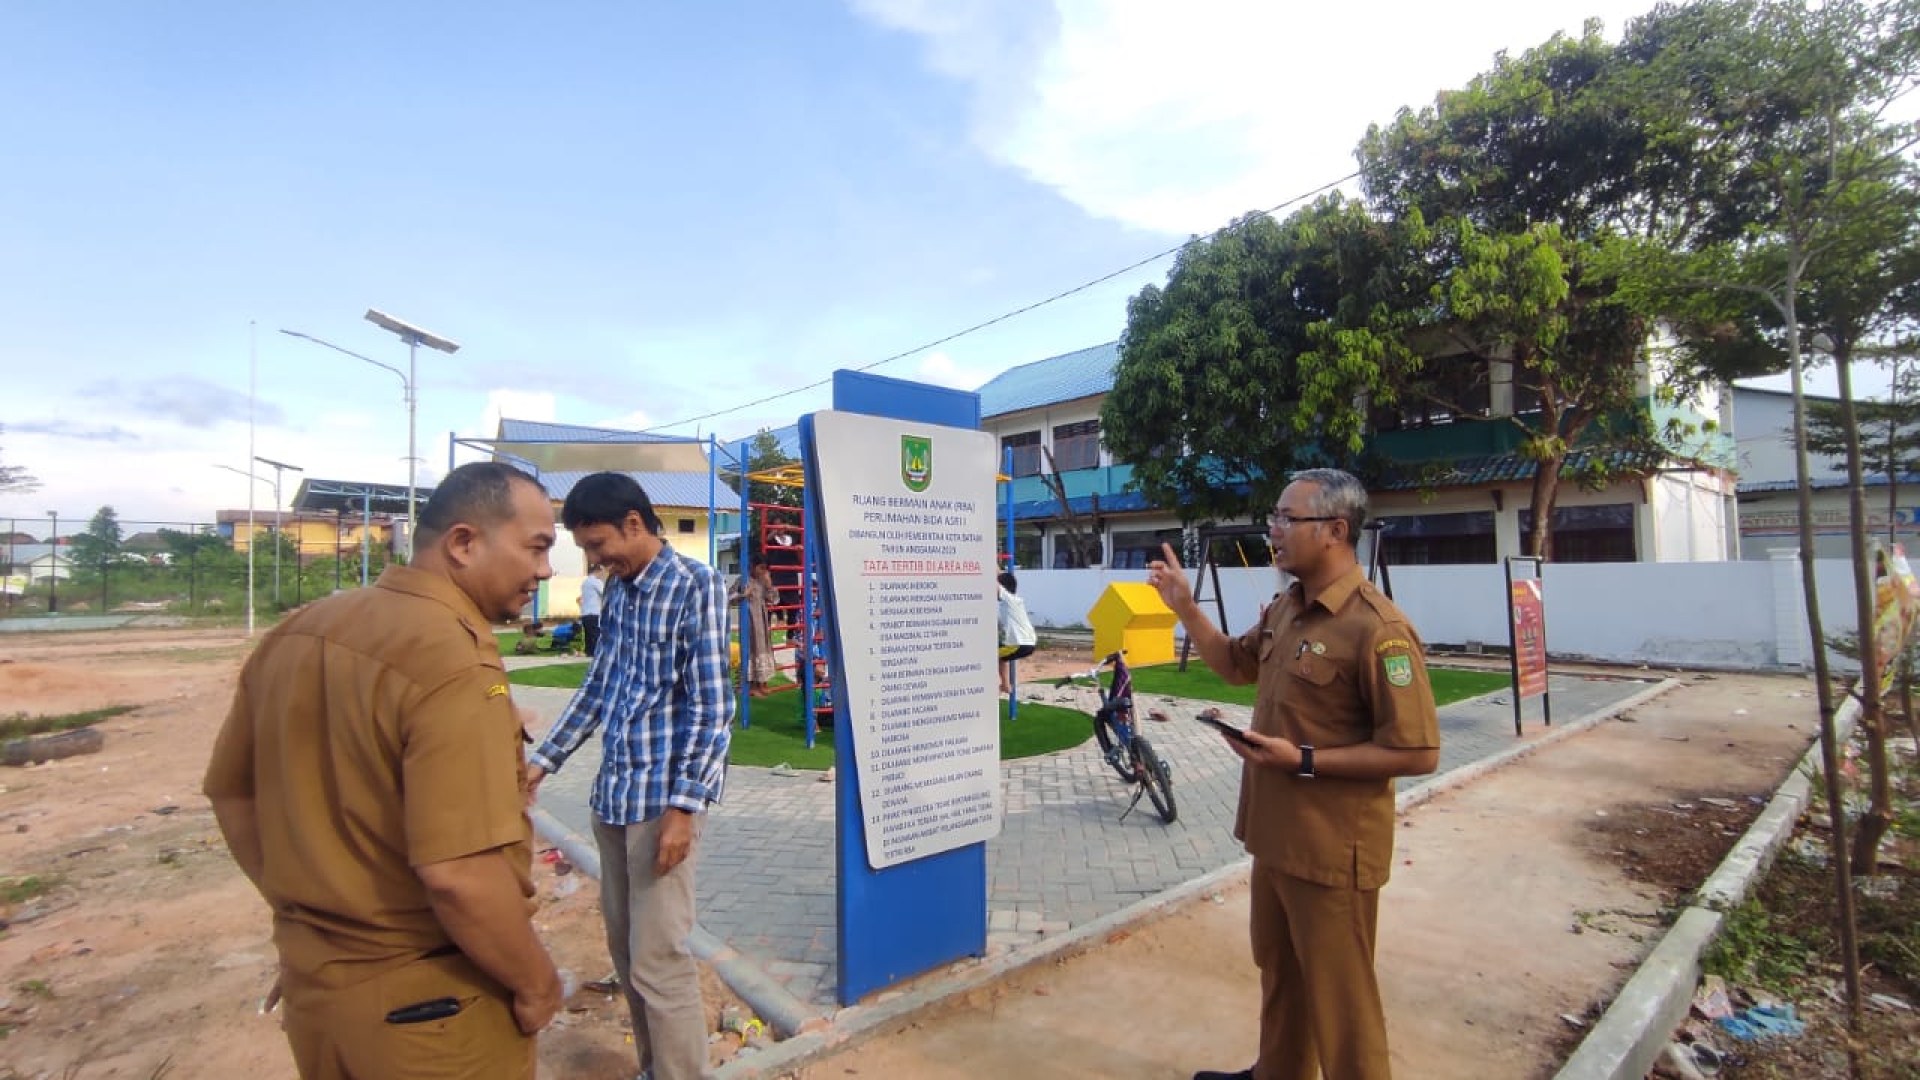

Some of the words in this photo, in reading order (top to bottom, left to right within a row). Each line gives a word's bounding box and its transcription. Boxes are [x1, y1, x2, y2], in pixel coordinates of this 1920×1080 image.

[852, 495, 886, 506] RUANG
[864, 512, 920, 525] PERUMAHAN
[864, 560, 888, 571] TATA
[891, 560, 924, 571] TERTIB
[926, 560, 936, 572] DI
[938, 560, 960, 572] AREA
